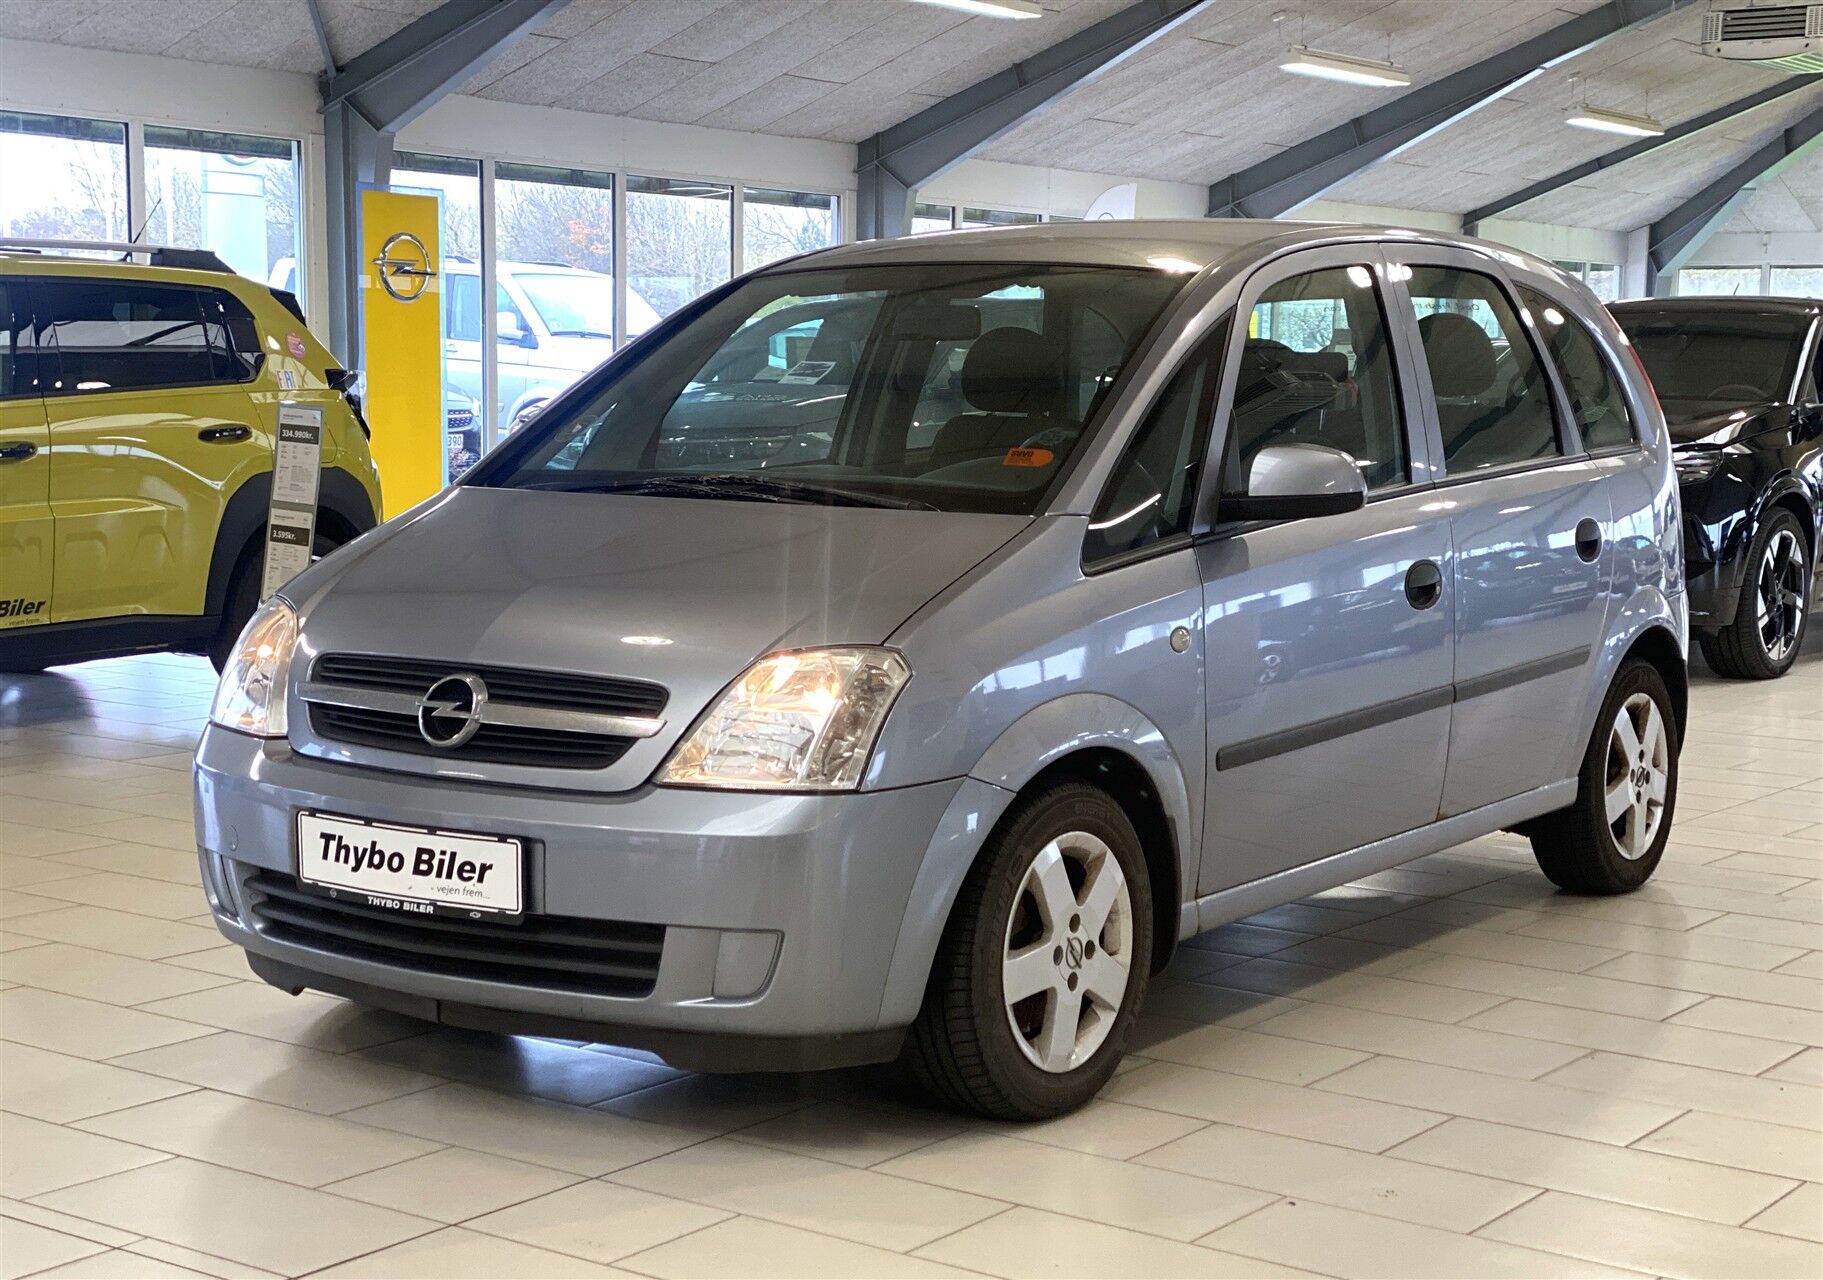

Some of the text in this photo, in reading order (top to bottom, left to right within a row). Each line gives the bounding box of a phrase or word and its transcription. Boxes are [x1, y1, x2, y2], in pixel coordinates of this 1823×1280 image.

[319, 831, 494, 884] Thybo Biler
[436, 885, 461, 896] vejen
[367, 896, 434, 915] THYBO BILER
